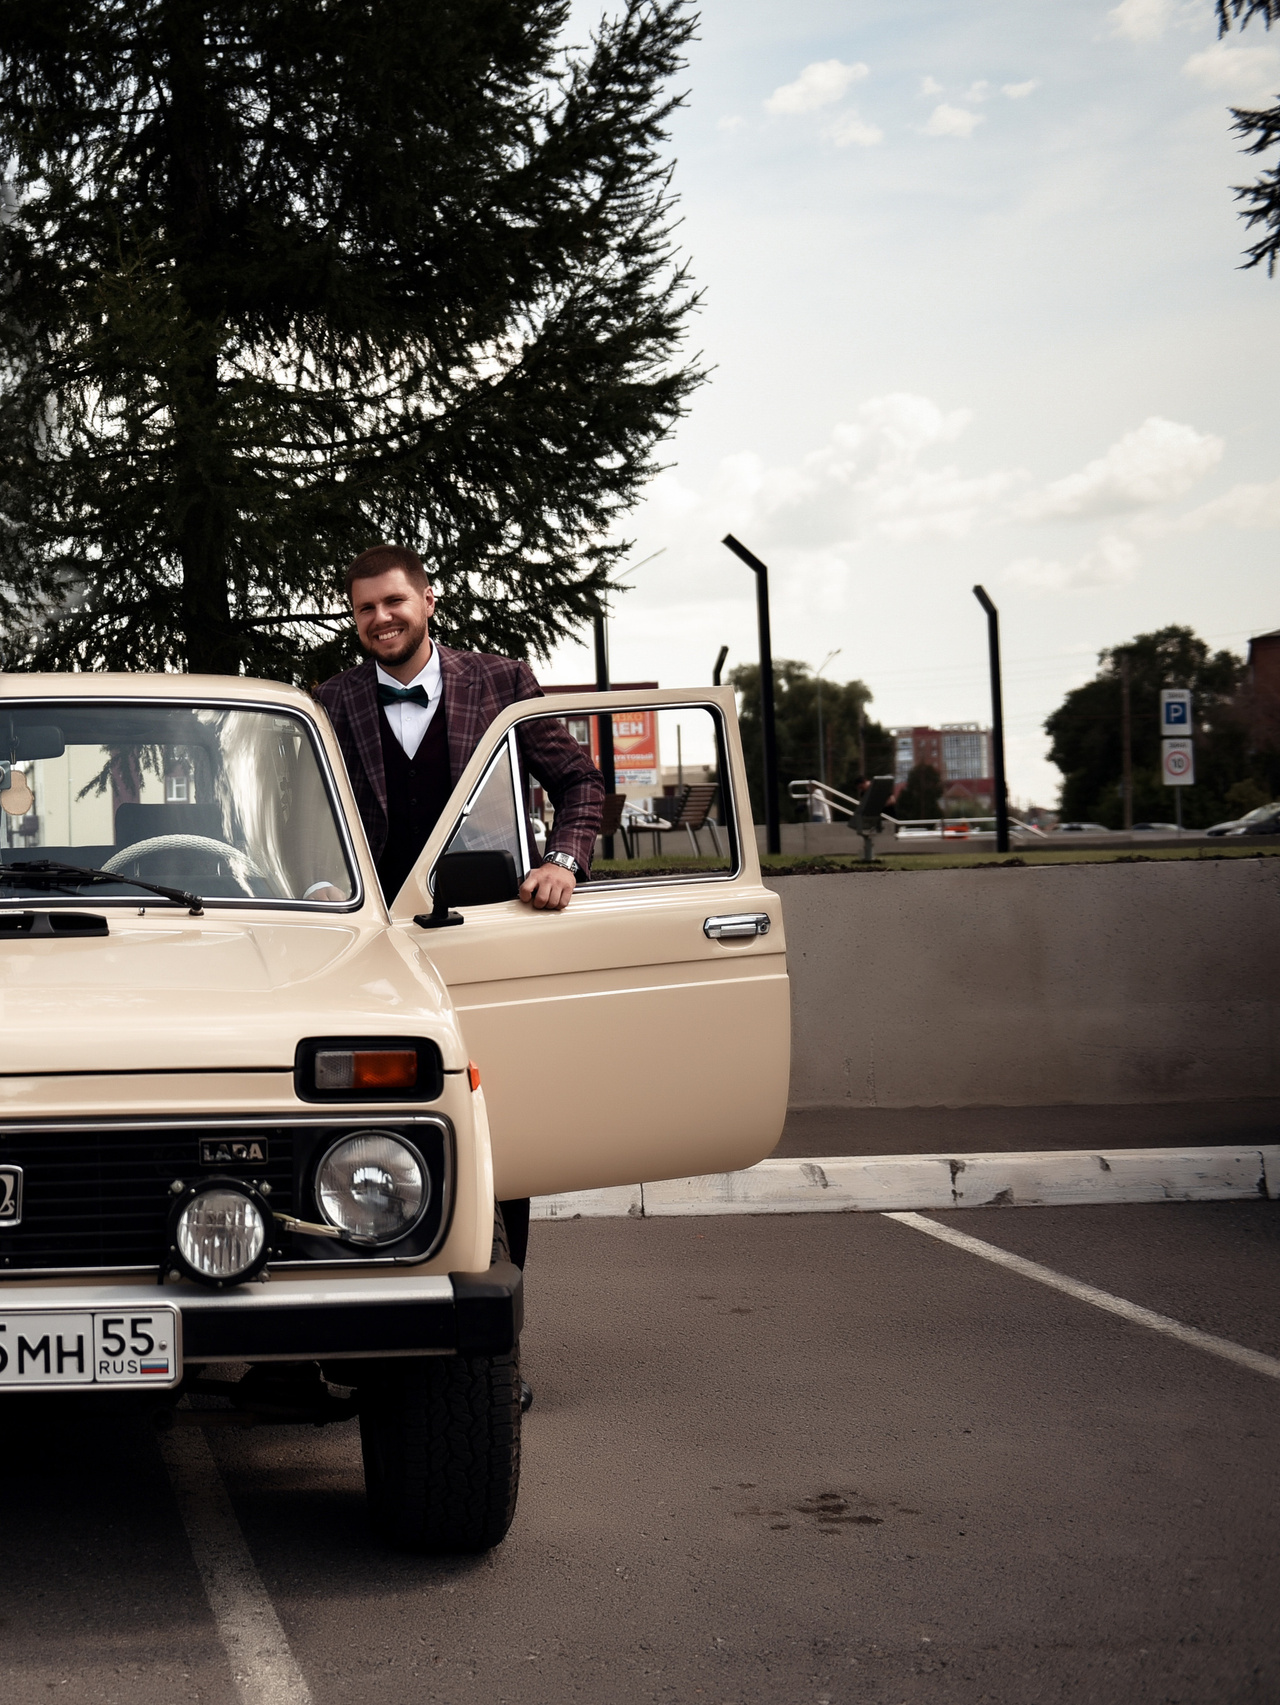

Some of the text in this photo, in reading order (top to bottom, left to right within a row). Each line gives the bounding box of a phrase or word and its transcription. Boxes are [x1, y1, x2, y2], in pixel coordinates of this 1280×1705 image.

[612, 713, 643, 722] ИЗКО
[1170, 704, 1183, 722] P
[1172, 757, 1185, 769] 10
[203, 1143, 264, 1161] LADA
[101, 1317, 155, 1357] 55
[99, 1360, 139, 1375] RUS
